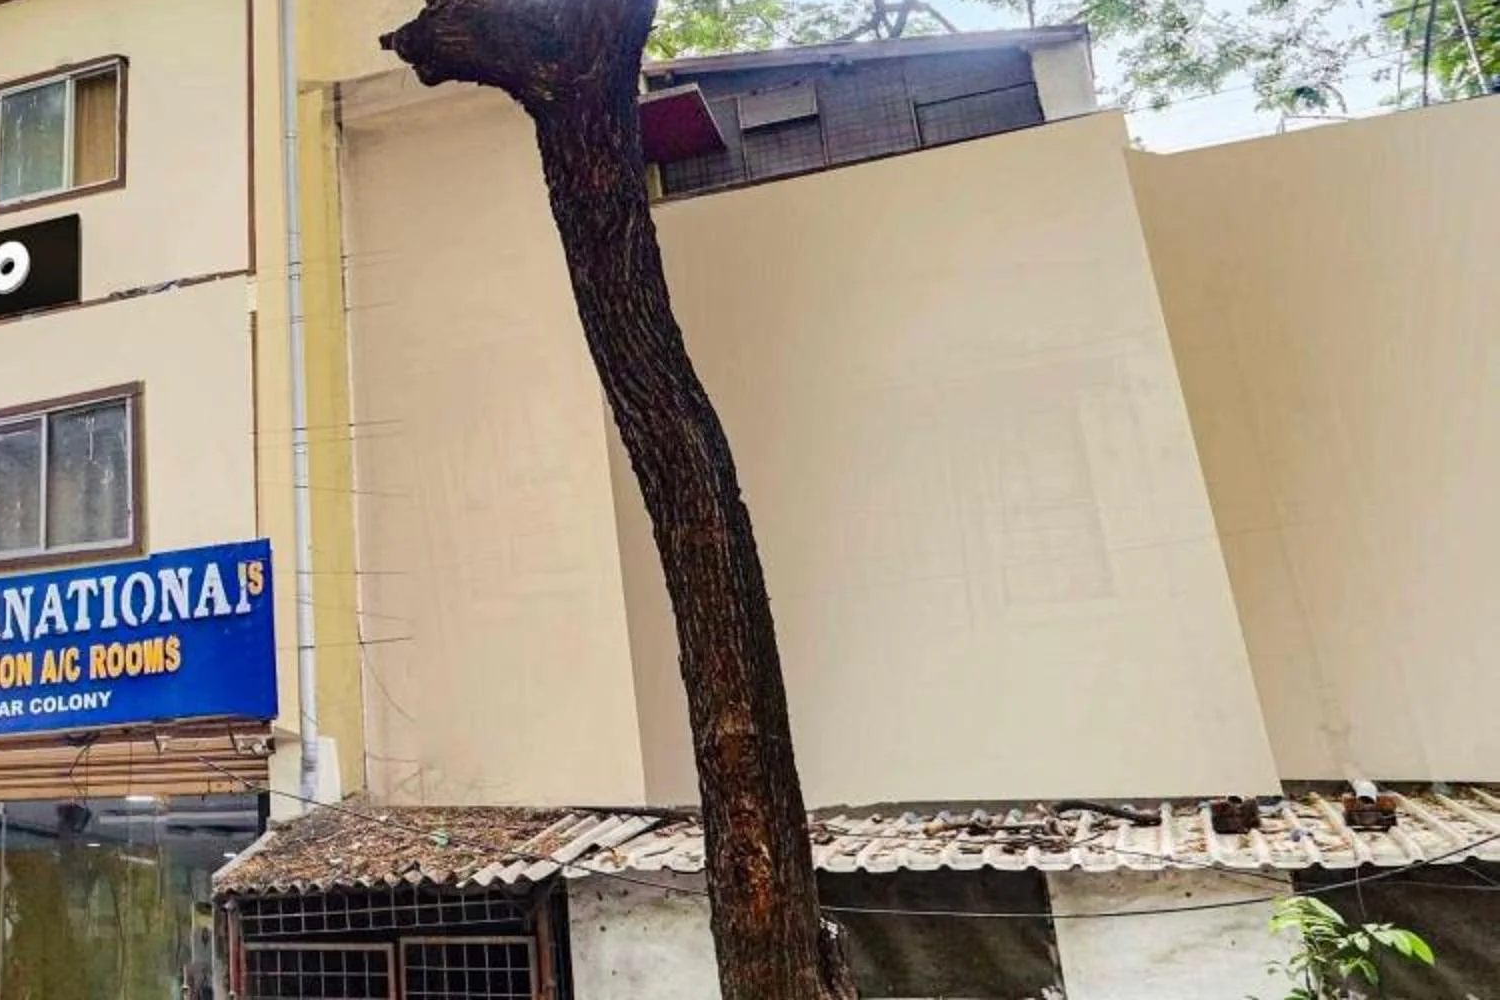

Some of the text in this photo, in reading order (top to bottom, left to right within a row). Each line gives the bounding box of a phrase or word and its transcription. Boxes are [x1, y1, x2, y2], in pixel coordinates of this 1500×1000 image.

[40, 647, 81, 685] A/C
[89, 633, 181, 680] ROOMS
[29, 691, 113, 715] COLONY
